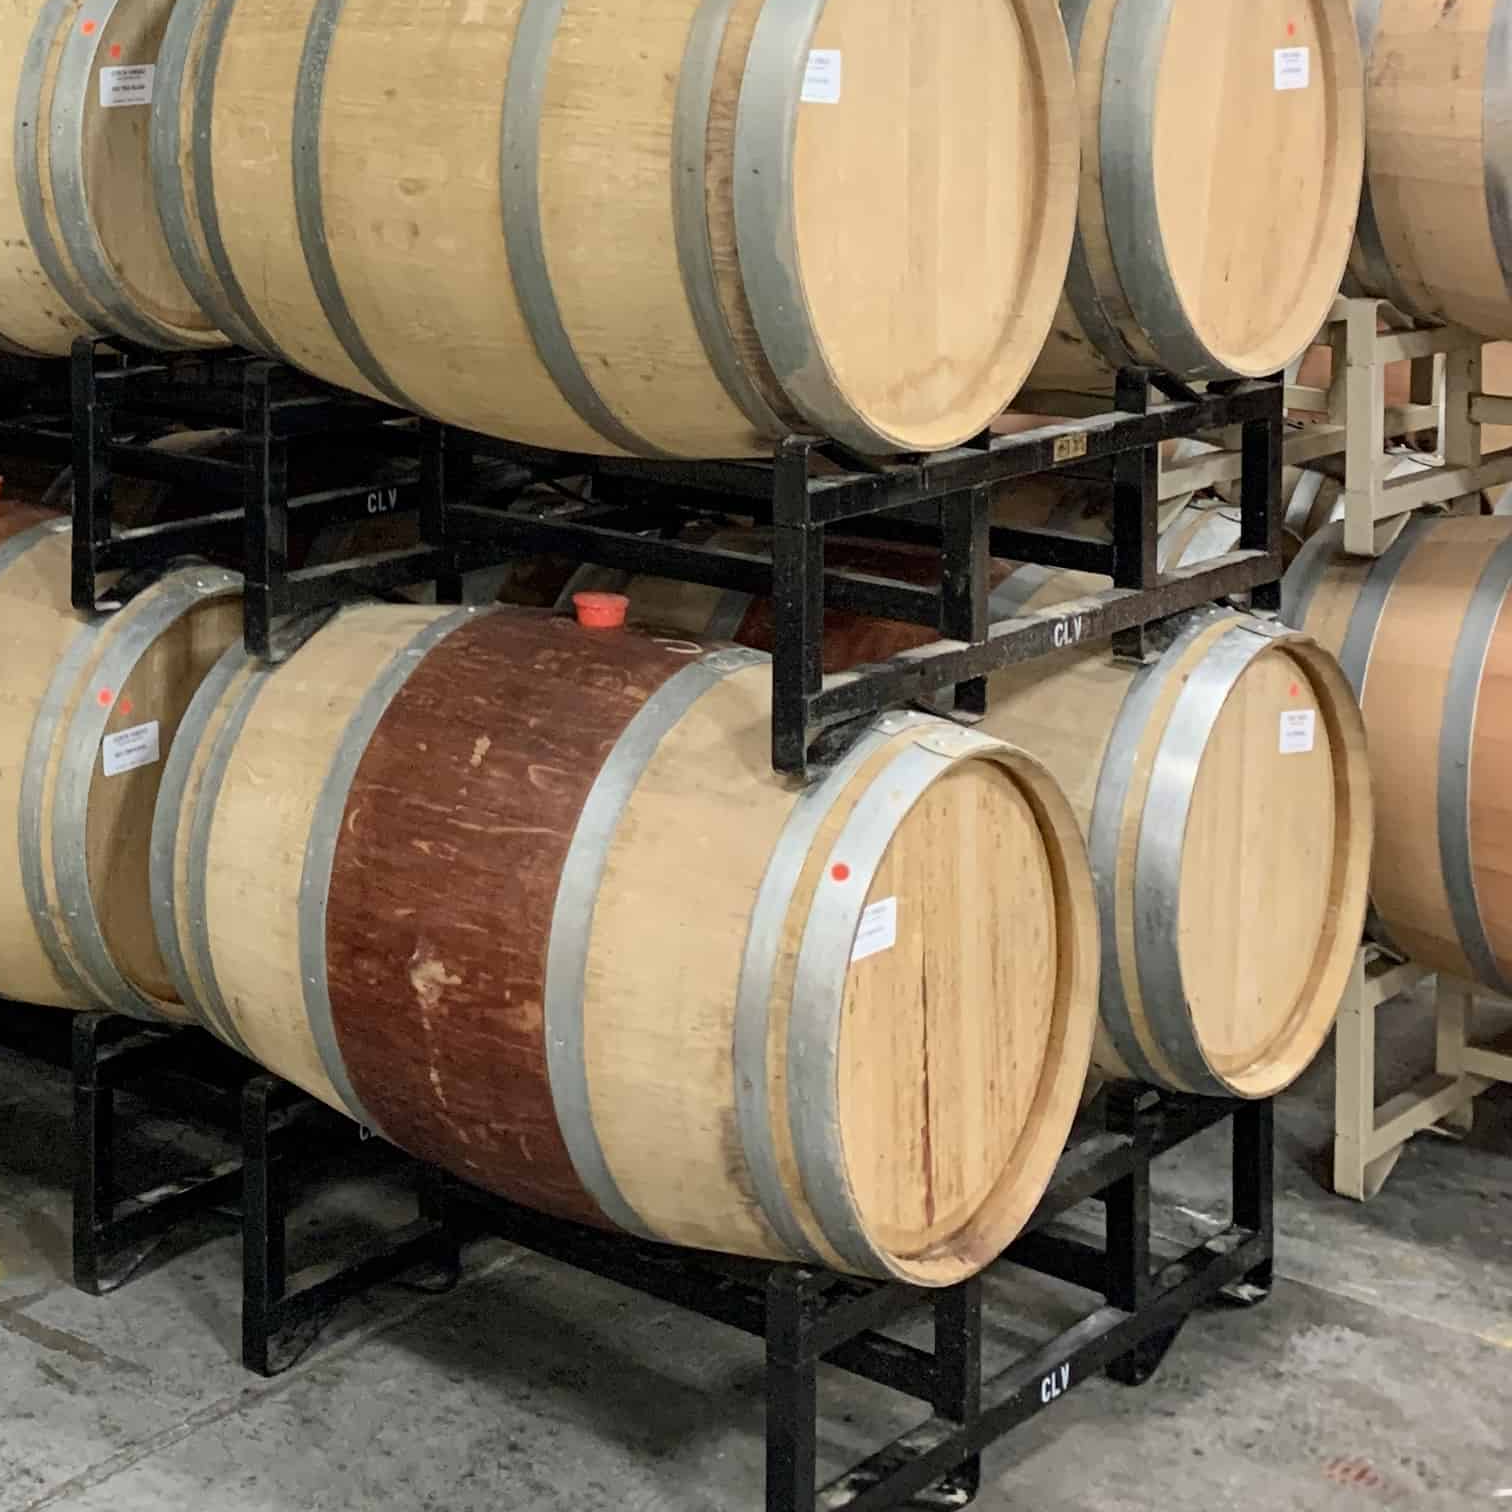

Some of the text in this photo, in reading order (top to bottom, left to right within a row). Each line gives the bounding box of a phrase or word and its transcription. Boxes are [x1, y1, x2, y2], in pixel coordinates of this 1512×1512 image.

[368, 488, 397, 514] CLV
[1054, 616, 1082, 647] CLV
[1041, 1362, 1070, 1403] CLV
